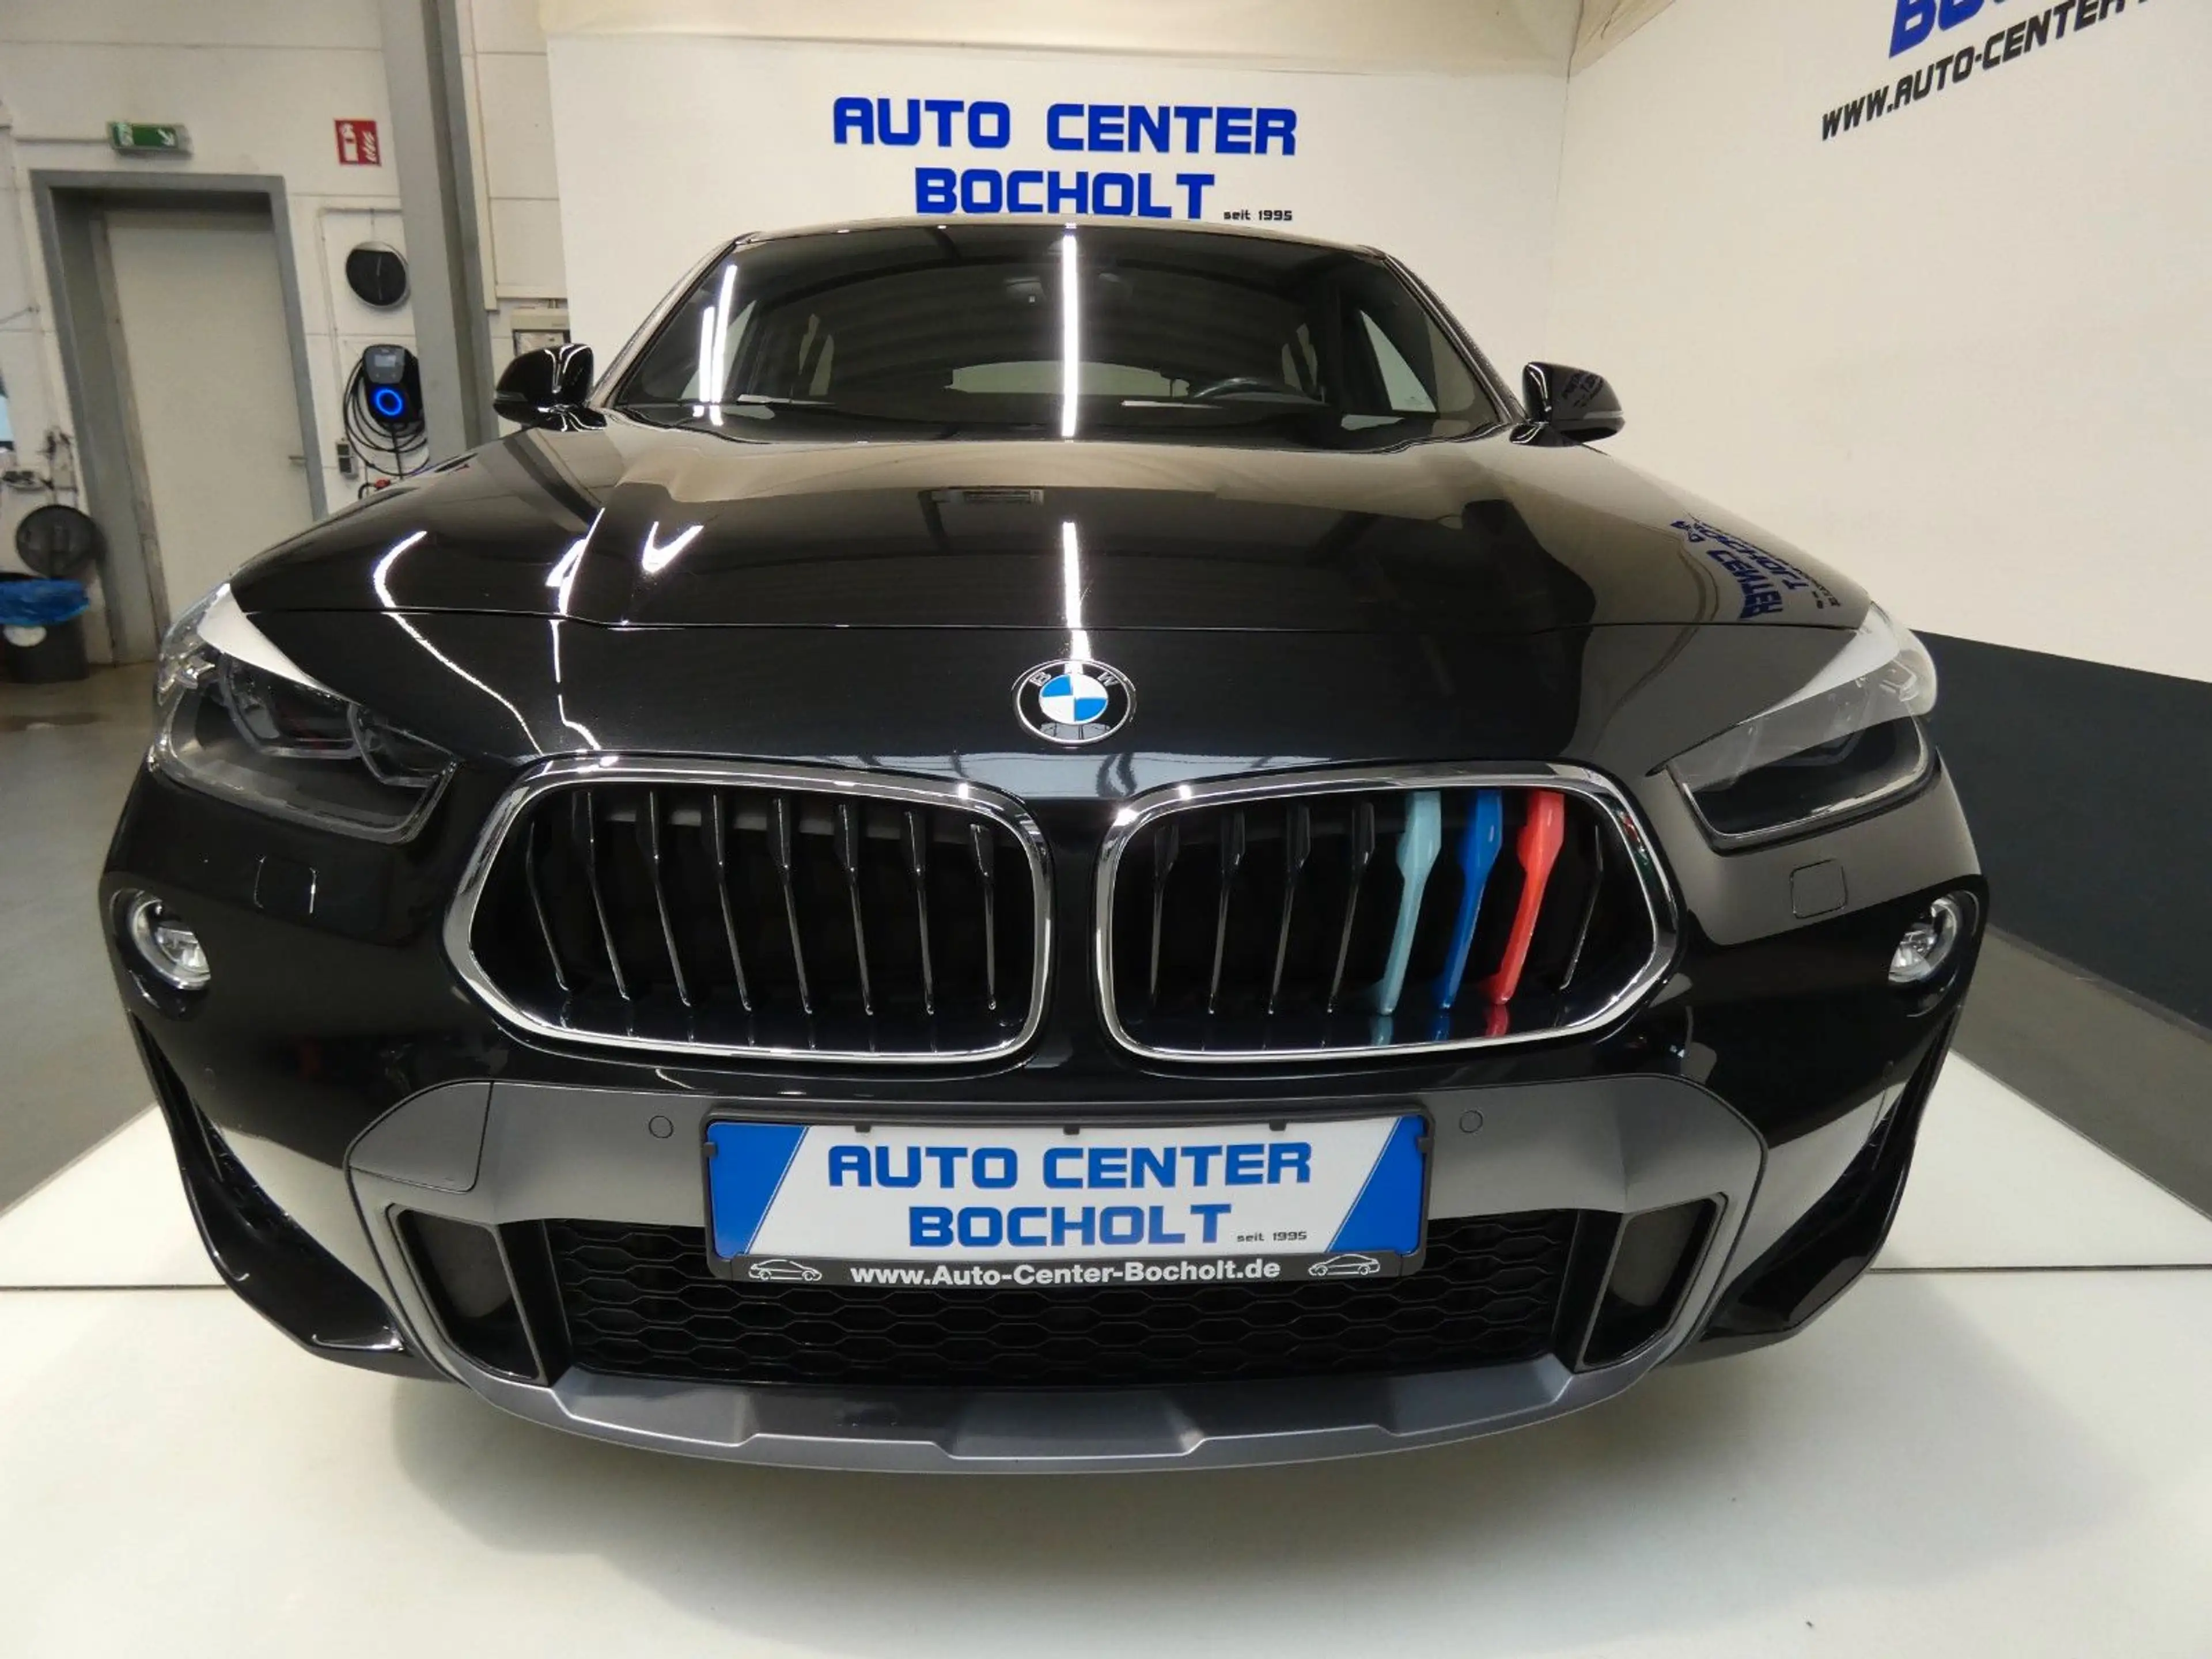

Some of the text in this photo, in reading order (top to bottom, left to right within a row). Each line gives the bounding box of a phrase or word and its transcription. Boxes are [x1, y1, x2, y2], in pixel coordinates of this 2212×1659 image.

[834, 96, 1298, 156] AUTO CENTER
[915, 166, 1215, 220] BOCHOLT
[1223, 209, 1293, 221] seit 1995
[828, 1141, 1312, 1191] AUTO CENTER
[908, 1202, 1233, 1249] BOCHOLT
[1237, 1231, 1307, 1242] seit 1995
[850, 1259, 1281, 1286] www.Auto-Center-Bocholt.de
